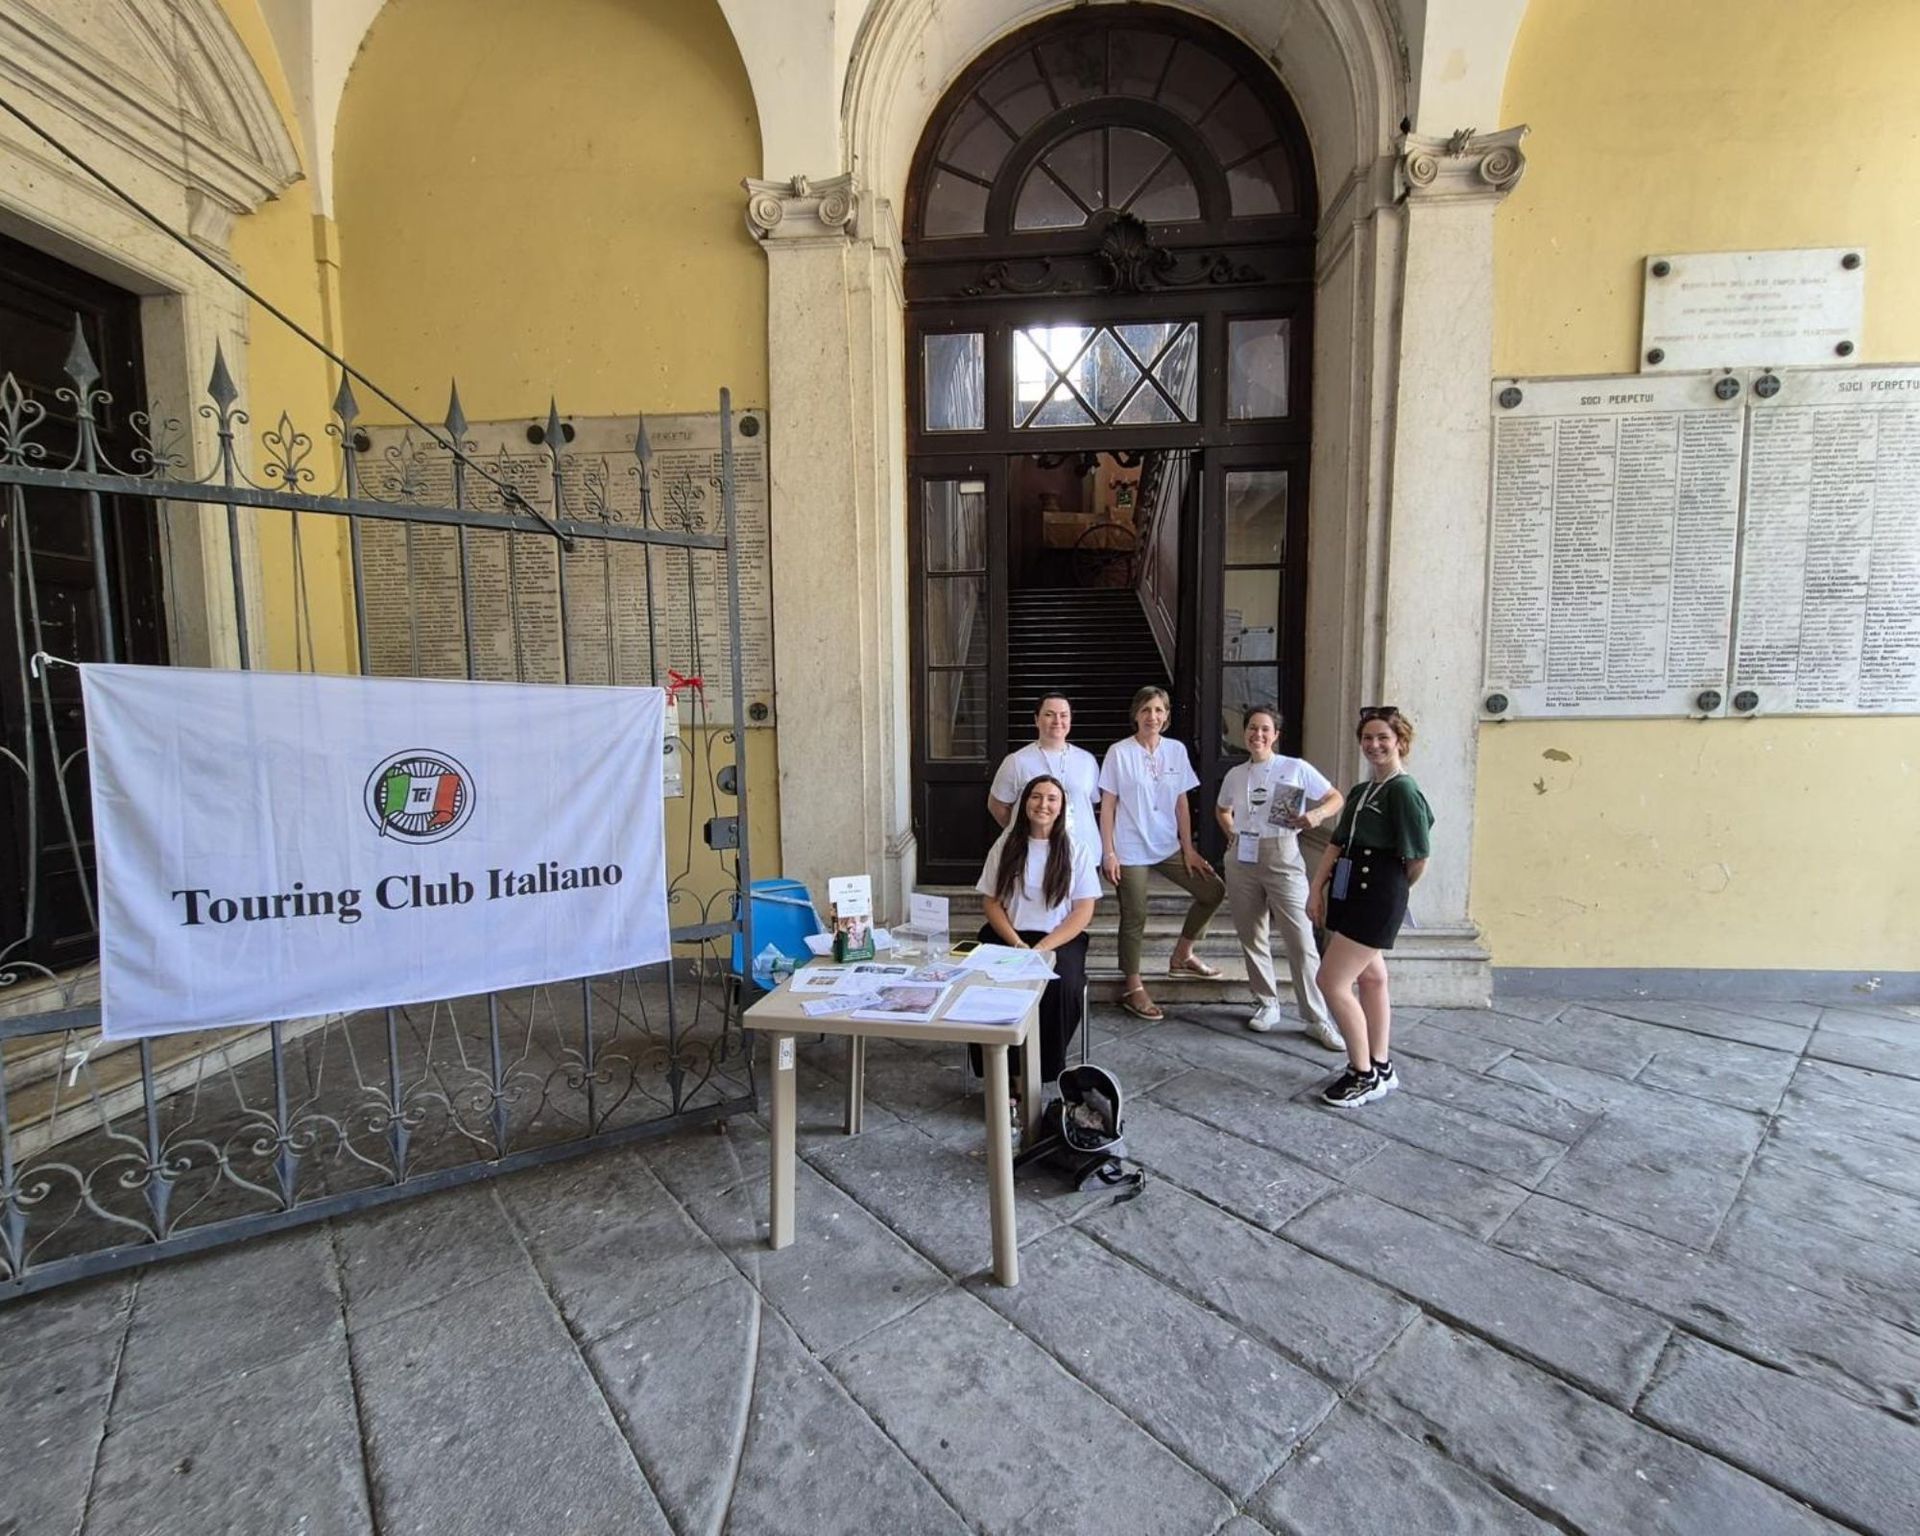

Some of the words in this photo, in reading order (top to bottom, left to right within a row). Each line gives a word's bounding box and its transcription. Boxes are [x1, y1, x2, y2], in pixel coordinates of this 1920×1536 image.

[1580, 395, 1602, 406] SOCI
[1609, 392, 1655, 405] PERPETUI
[171, 881, 363, 927] Touring
[374, 870, 475, 911] Club
[487, 860, 624, 902] Italiano
